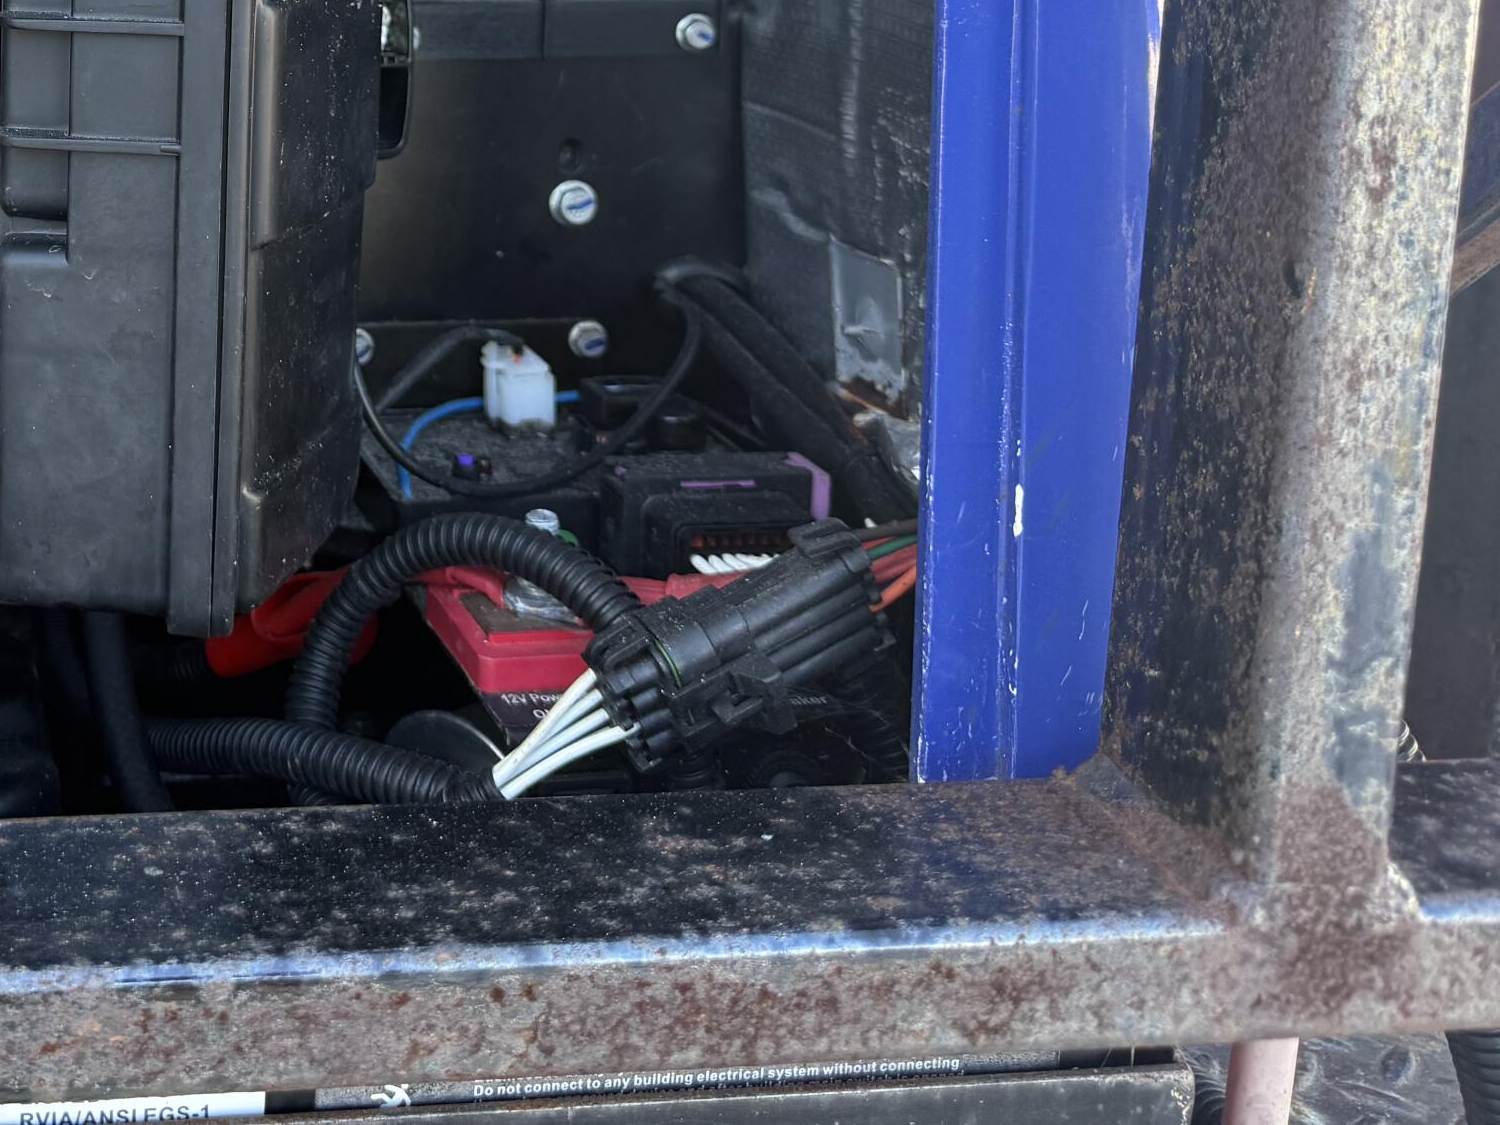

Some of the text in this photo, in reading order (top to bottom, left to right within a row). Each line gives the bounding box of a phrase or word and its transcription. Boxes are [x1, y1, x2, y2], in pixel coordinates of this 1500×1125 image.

[501, 693, 528, 705] 12V
[474, 1084, 492, 1097] Do
[497, 1083, 521, 1095] not
[524, 1079, 584, 1094] connect
[586, 1078, 600, 1090] to
[604, 1077, 630, 1091] any
[634, 1072, 693, 1087] building
[697, 1066, 764, 1082] electrical
[768, 1065, 819, 1080] system
[822, 1061, 876, 1075] without
[880, 1057, 960, 1073] connecting
